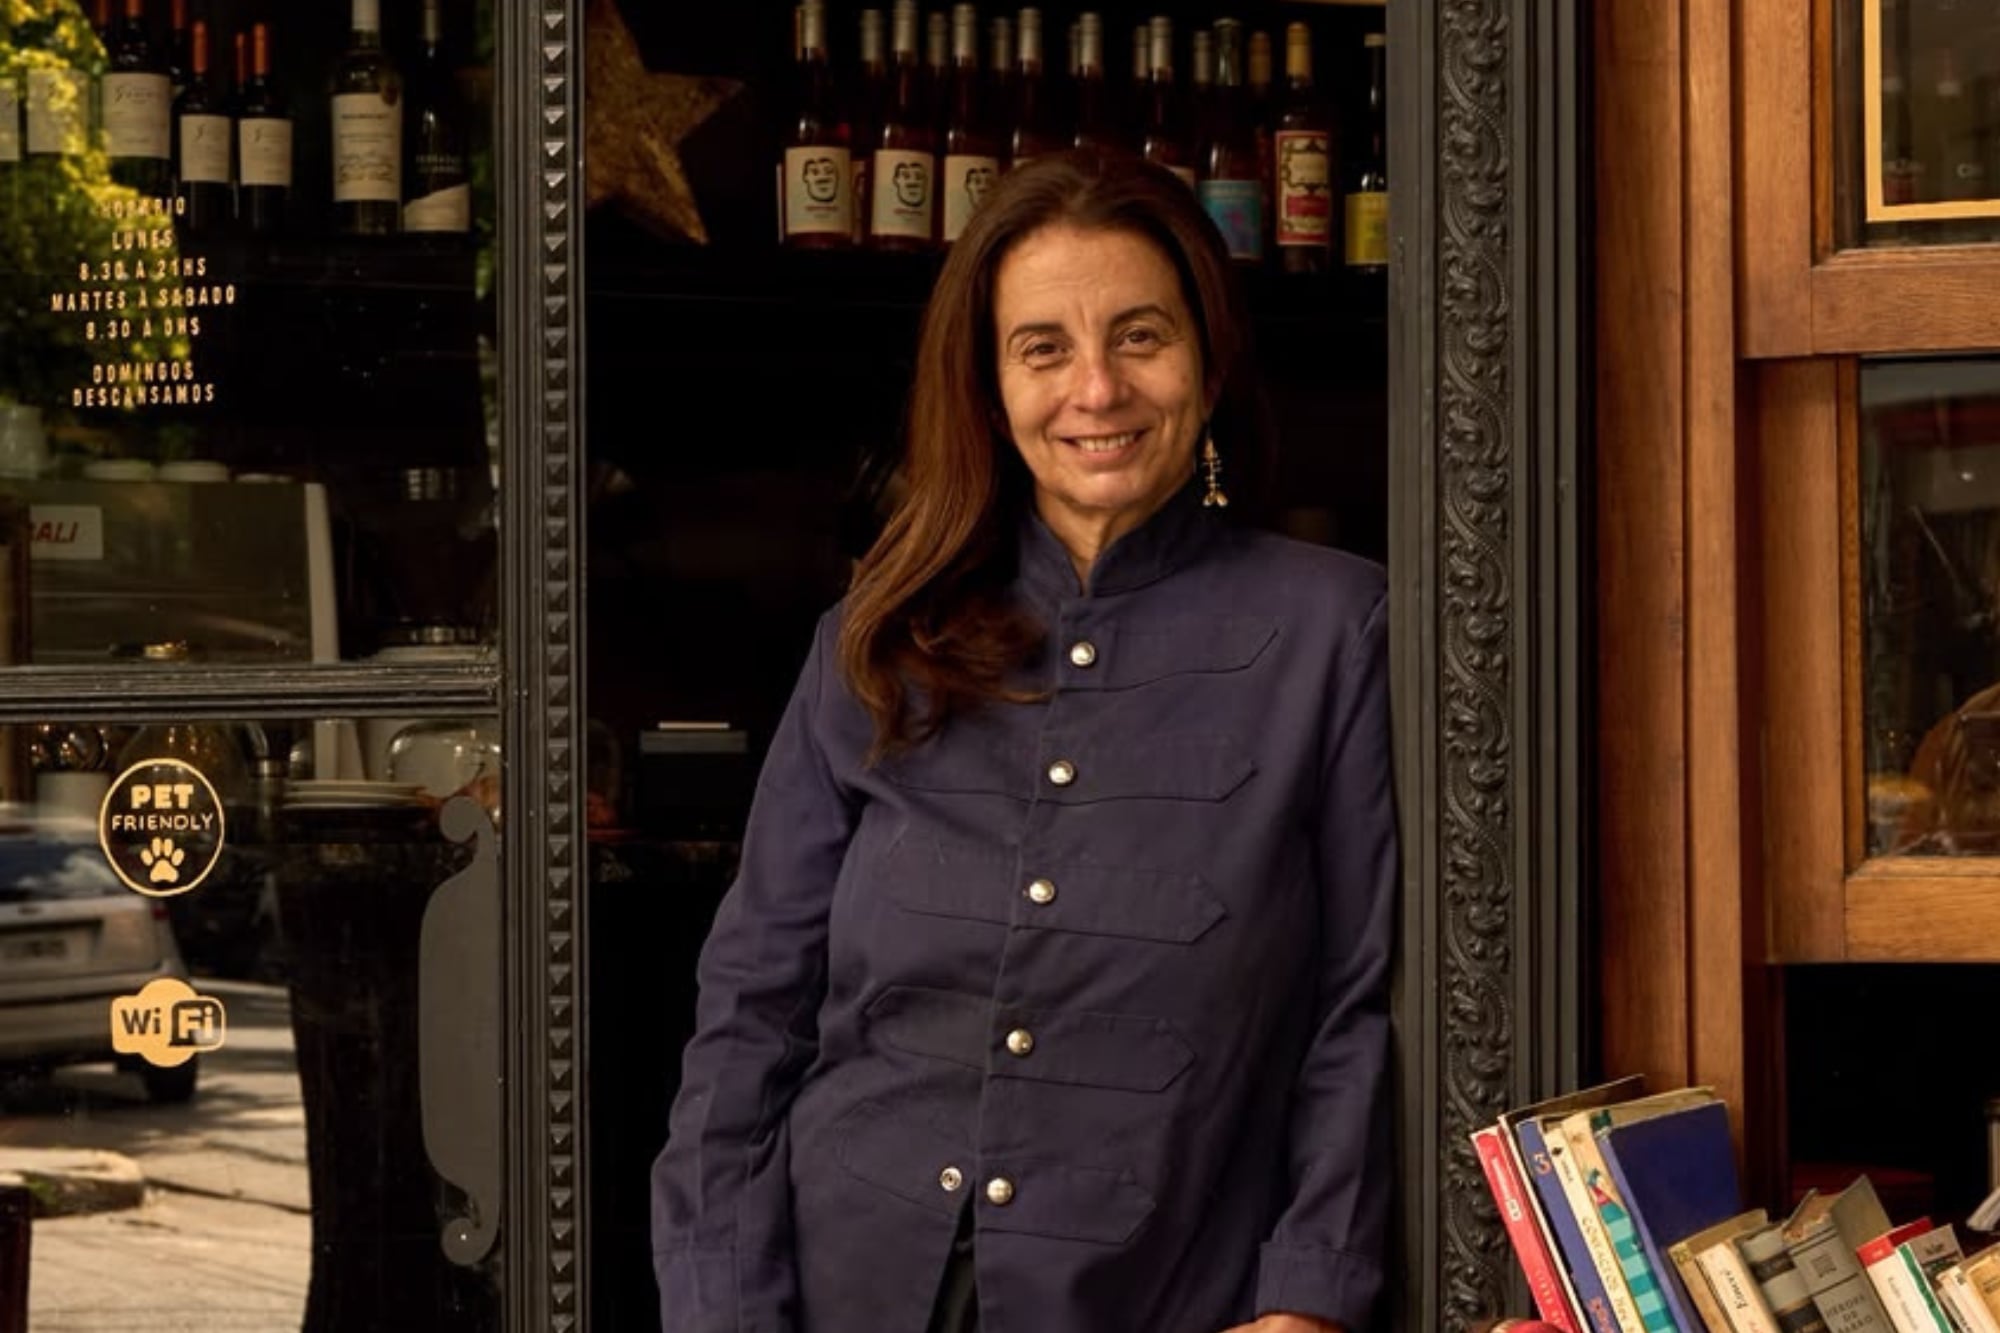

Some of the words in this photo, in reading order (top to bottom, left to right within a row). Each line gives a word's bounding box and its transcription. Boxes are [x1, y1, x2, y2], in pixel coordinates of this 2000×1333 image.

[112, 229, 174, 250] LUNES
[79, 260, 124, 281] 8.30
[135, 260, 147, 279] A
[157, 257, 207, 278] 21HS
[51, 290, 127, 312] MARTES
[138, 289, 148, 308] A
[158, 284, 236, 308] SABADO
[142, 319, 153, 337] A
[92, 360, 194, 384] DOMINGOS
[73, 383, 215, 408] DESCANSAMOS
[28, 521, 79, 543] ALI
[130, 784, 195, 810] PET
[111, 813, 214, 831] FRIENDLY
